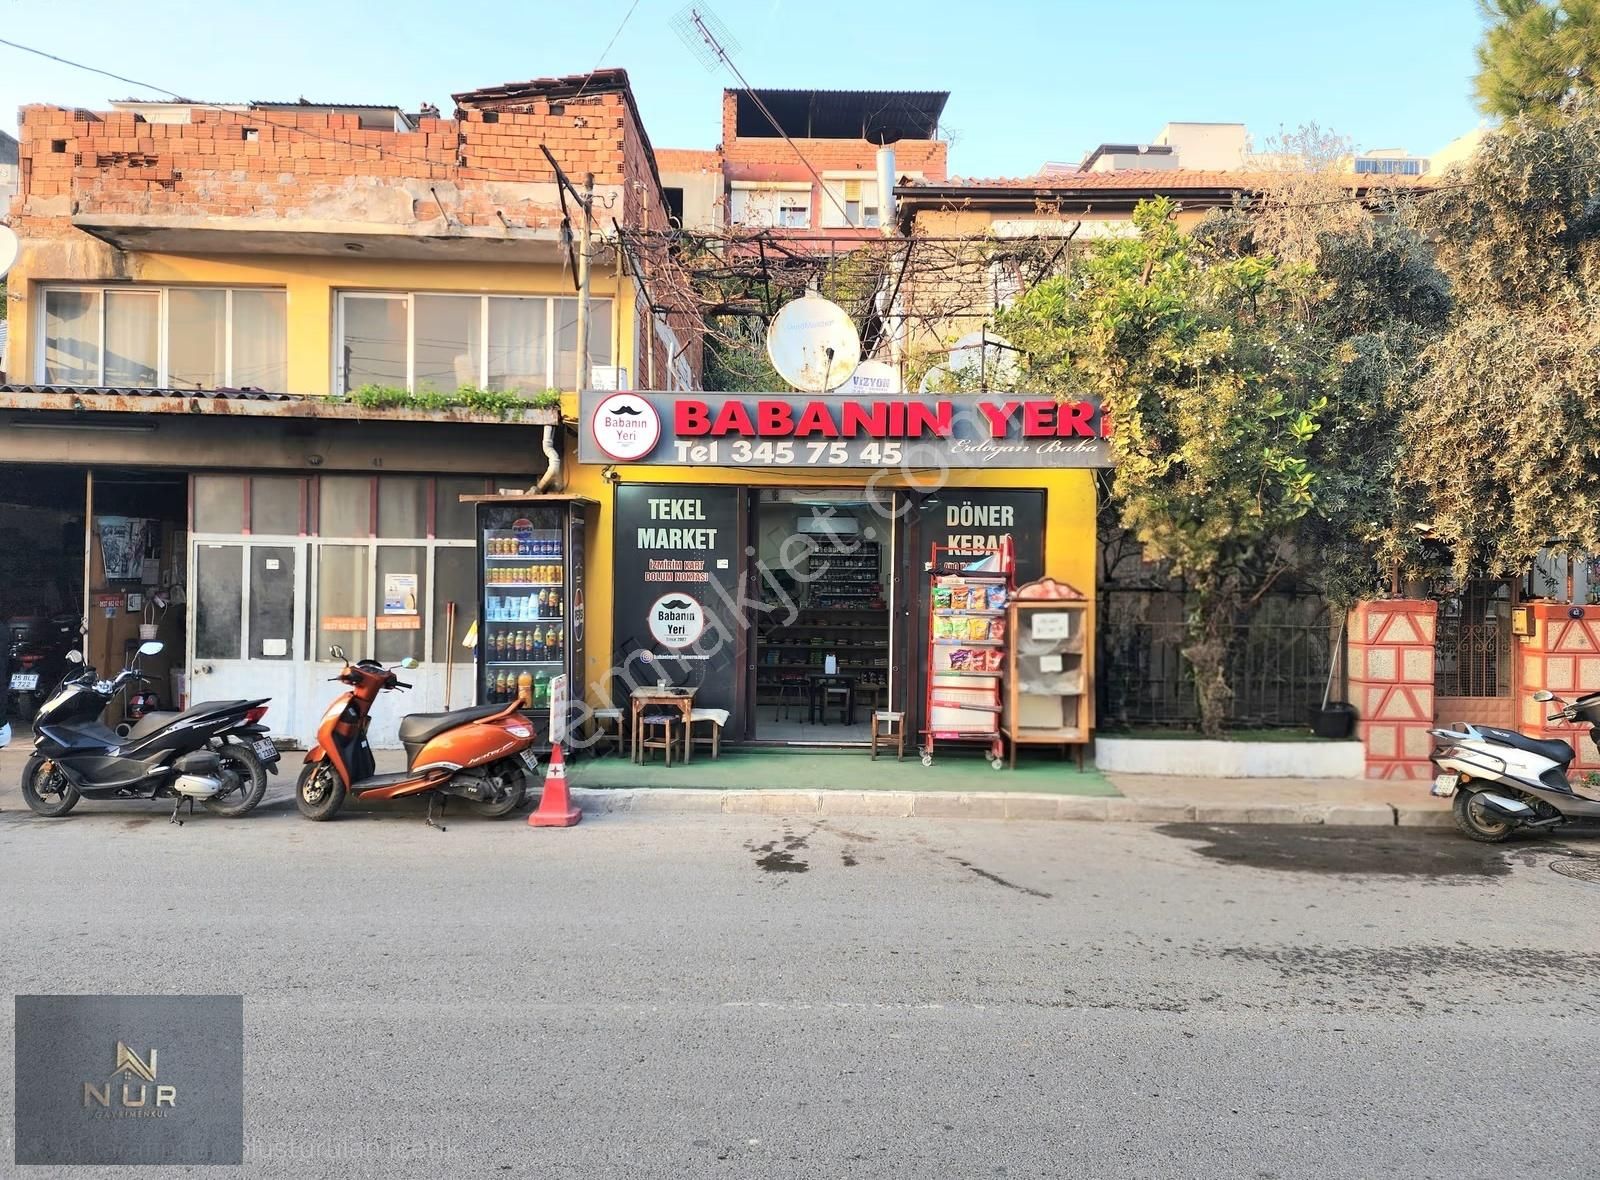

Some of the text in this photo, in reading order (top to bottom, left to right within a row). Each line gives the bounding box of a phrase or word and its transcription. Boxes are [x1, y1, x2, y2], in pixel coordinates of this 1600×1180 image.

[605, 416, 647, 429] Babanın
[674, 400, 953, 438] BABANIN
[616, 430, 636, 441] Yeri
[674, 440, 902, 465] Tel 345 75 45
[1036, 436, 1098, 454] Baba
[647, 498, 706, 520] TEKEL
[946, 500, 1014, 527] DÖNER
[637, 528, 718, 550] MARKET
[684, 560, 704, 571] KART
[644, 571, 709, 582] DOLUM NOKTASI
[658, 611, 695, 621] Babanın
[667, 624, 685, 635] Yeri
